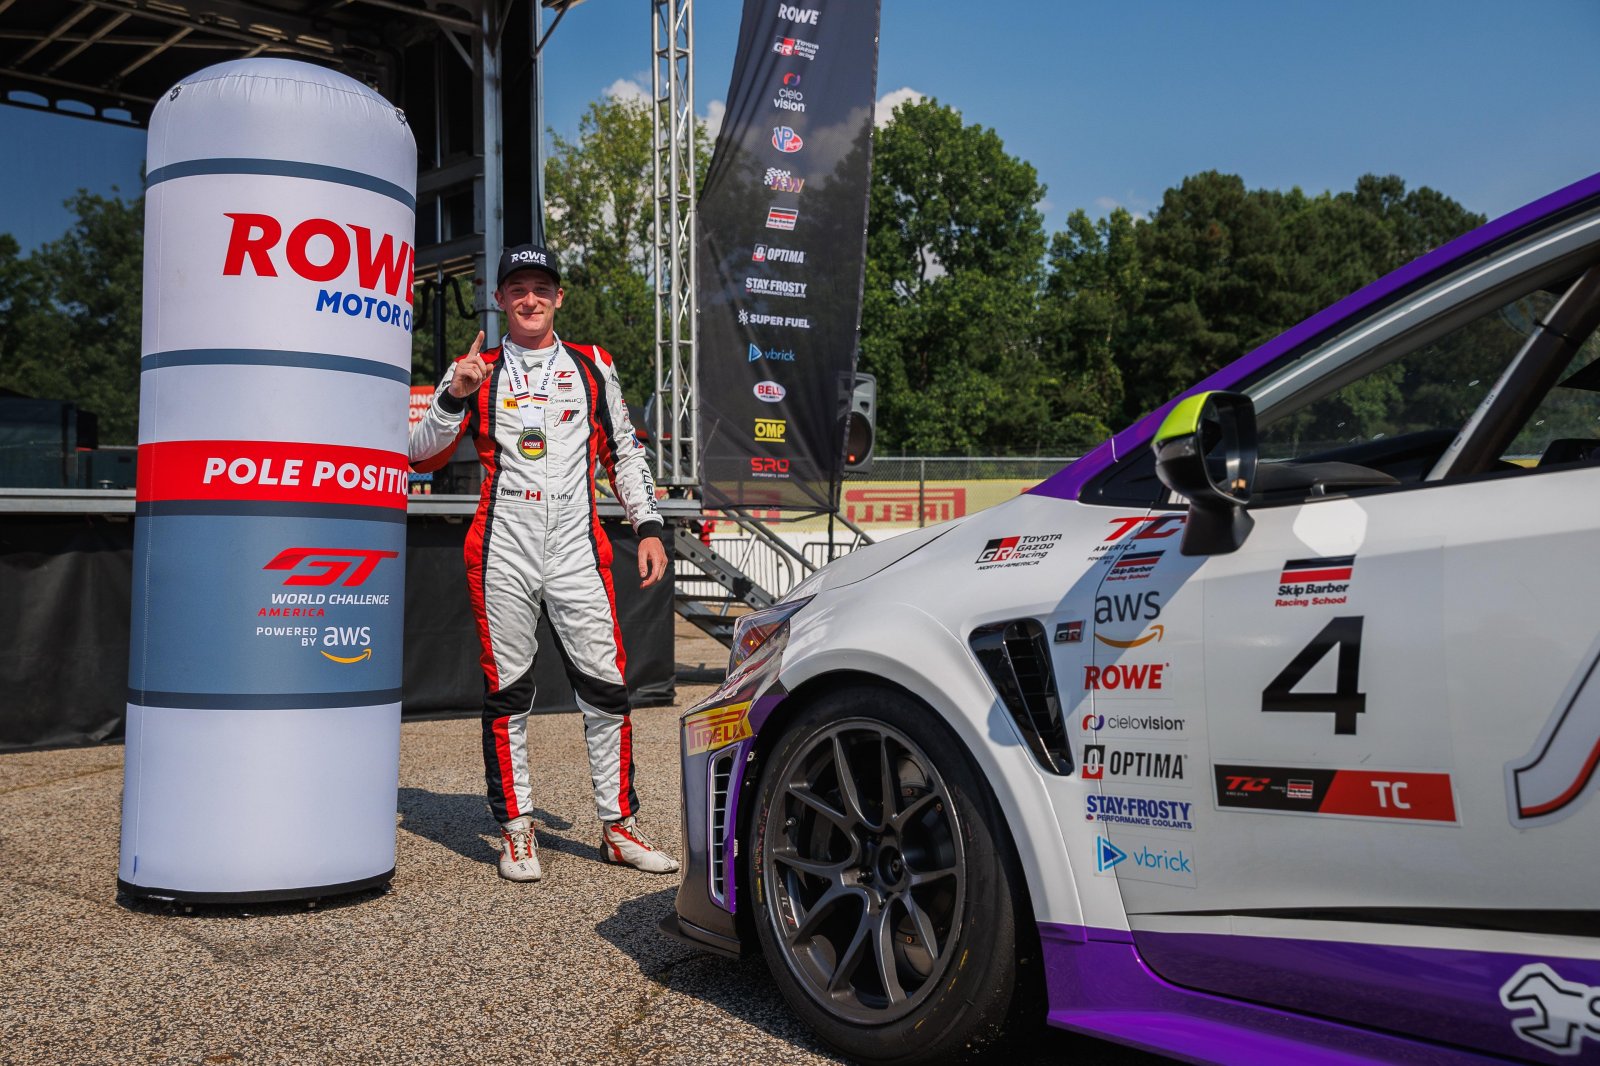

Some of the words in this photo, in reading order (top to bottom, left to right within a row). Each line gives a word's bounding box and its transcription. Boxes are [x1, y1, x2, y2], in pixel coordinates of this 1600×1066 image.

[778, 3, 819, 25] ROWE
[773, 41, 792, 56] GR
[778, 88, 803, 101] cielo
[773, 98, 805, 112] vision
[773, 126, 794, 151] VP
[511, 250, 546, 264] ROWE
[767, 248, 804, 264] OPTIMA
[315, 289, 401, 328] MOTOR
[750, 314, 783, 326] SUPER
[784, 317, 810, 328] FUEL
[765, 348, 795, 361] vbrick
[758, 385, 783, 396] BELL
[754, 423, 785, 438] OMP
[203, 457, 303, 486] POLE
[751, 457, 790, 472] SRO
[1104, 515, 1187, 542] TC
[1022, 534, 1063, 543] TOYOTA
[978, 547, 1013, 561] GR
[1017, 543, 1055, 552] GAZOO
[1093, 544, 1137, 552] AMERICA
[1011, 551, 1048, 560] Racing
[262, 547, 399, 587] GT
[1003, 560, 1040, 568] AMERICA
[1278, 585, 1304, 597] Skip
[1305, 583, 1349, 594] Barber
[271, 593, 325, 605] WORLD
[328, 593, 389, 605] CHALLENGE
[1275, 598, 1309, 607] Racing
[1312, 596, 1347, 605] School
[257, 607, 325, 617] AMERICA
[1095, 591, 1161, 625] aws
[256, 626, 318, 636] POWERED
[323, 626, 371, 646] aws
[301, 637, 316, 647] BY
[1055, 629, 1081, 641] GR
[1084, 664, 1164, 690] ROWE
[1261, 615, 1367, 735] 4
[1108, 715, 1183, 731] cielovision
[1110, 751, 1184, 780] OPTIMA
[1225, 776, 1271, 791] TC
[1370, 781, 1411, 809] TC
[1096, 814, 1150, 826] PERFORMANCE
[1152, 819, 1193, 829] COOLANTS
[1133, 846, 1191, 873] vbrick
